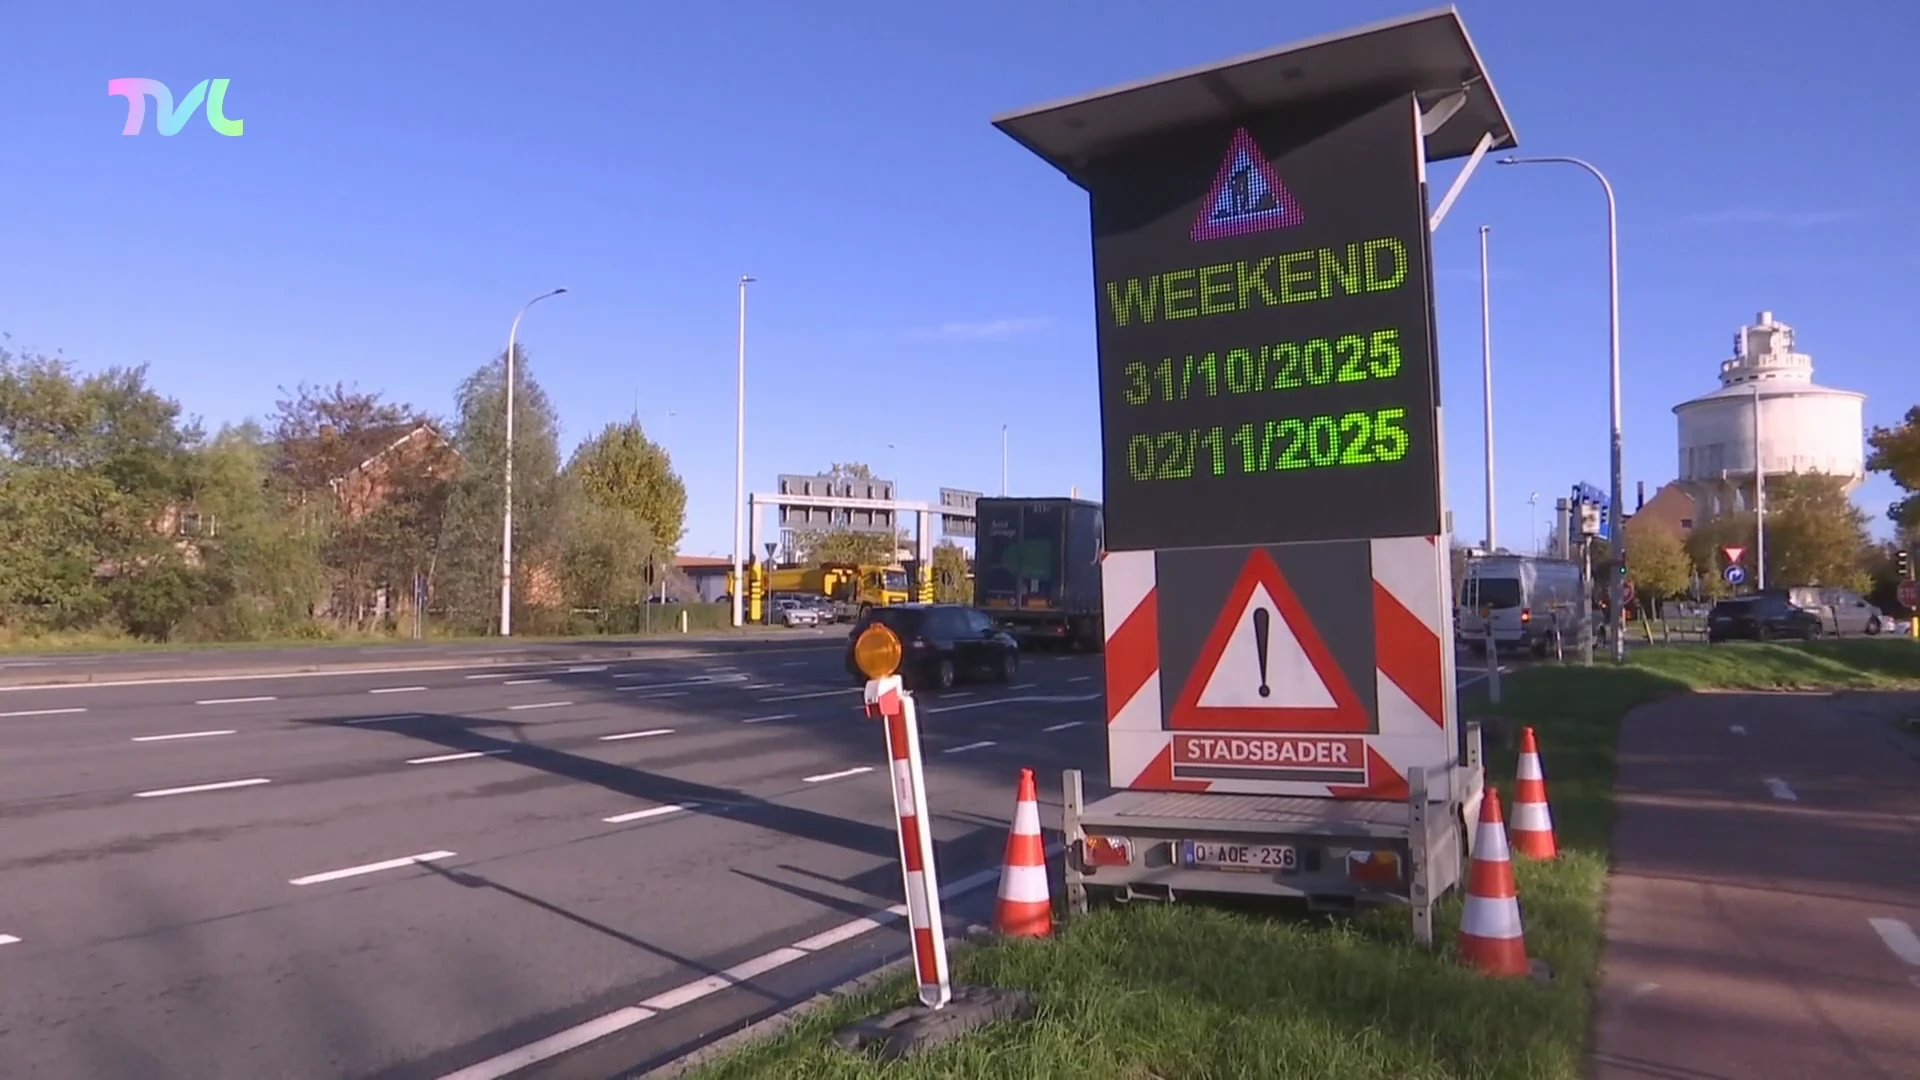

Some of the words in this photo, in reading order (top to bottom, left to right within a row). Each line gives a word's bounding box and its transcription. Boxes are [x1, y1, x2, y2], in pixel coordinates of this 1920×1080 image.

[1106, 237, 1409, 327] WEEKEND
[1123, 328, 1400, 405] 31/10/2025
[1127, 408, 1409, 481] 02/11/2025
[1188, 738, 1348, 763] STADSBADER
